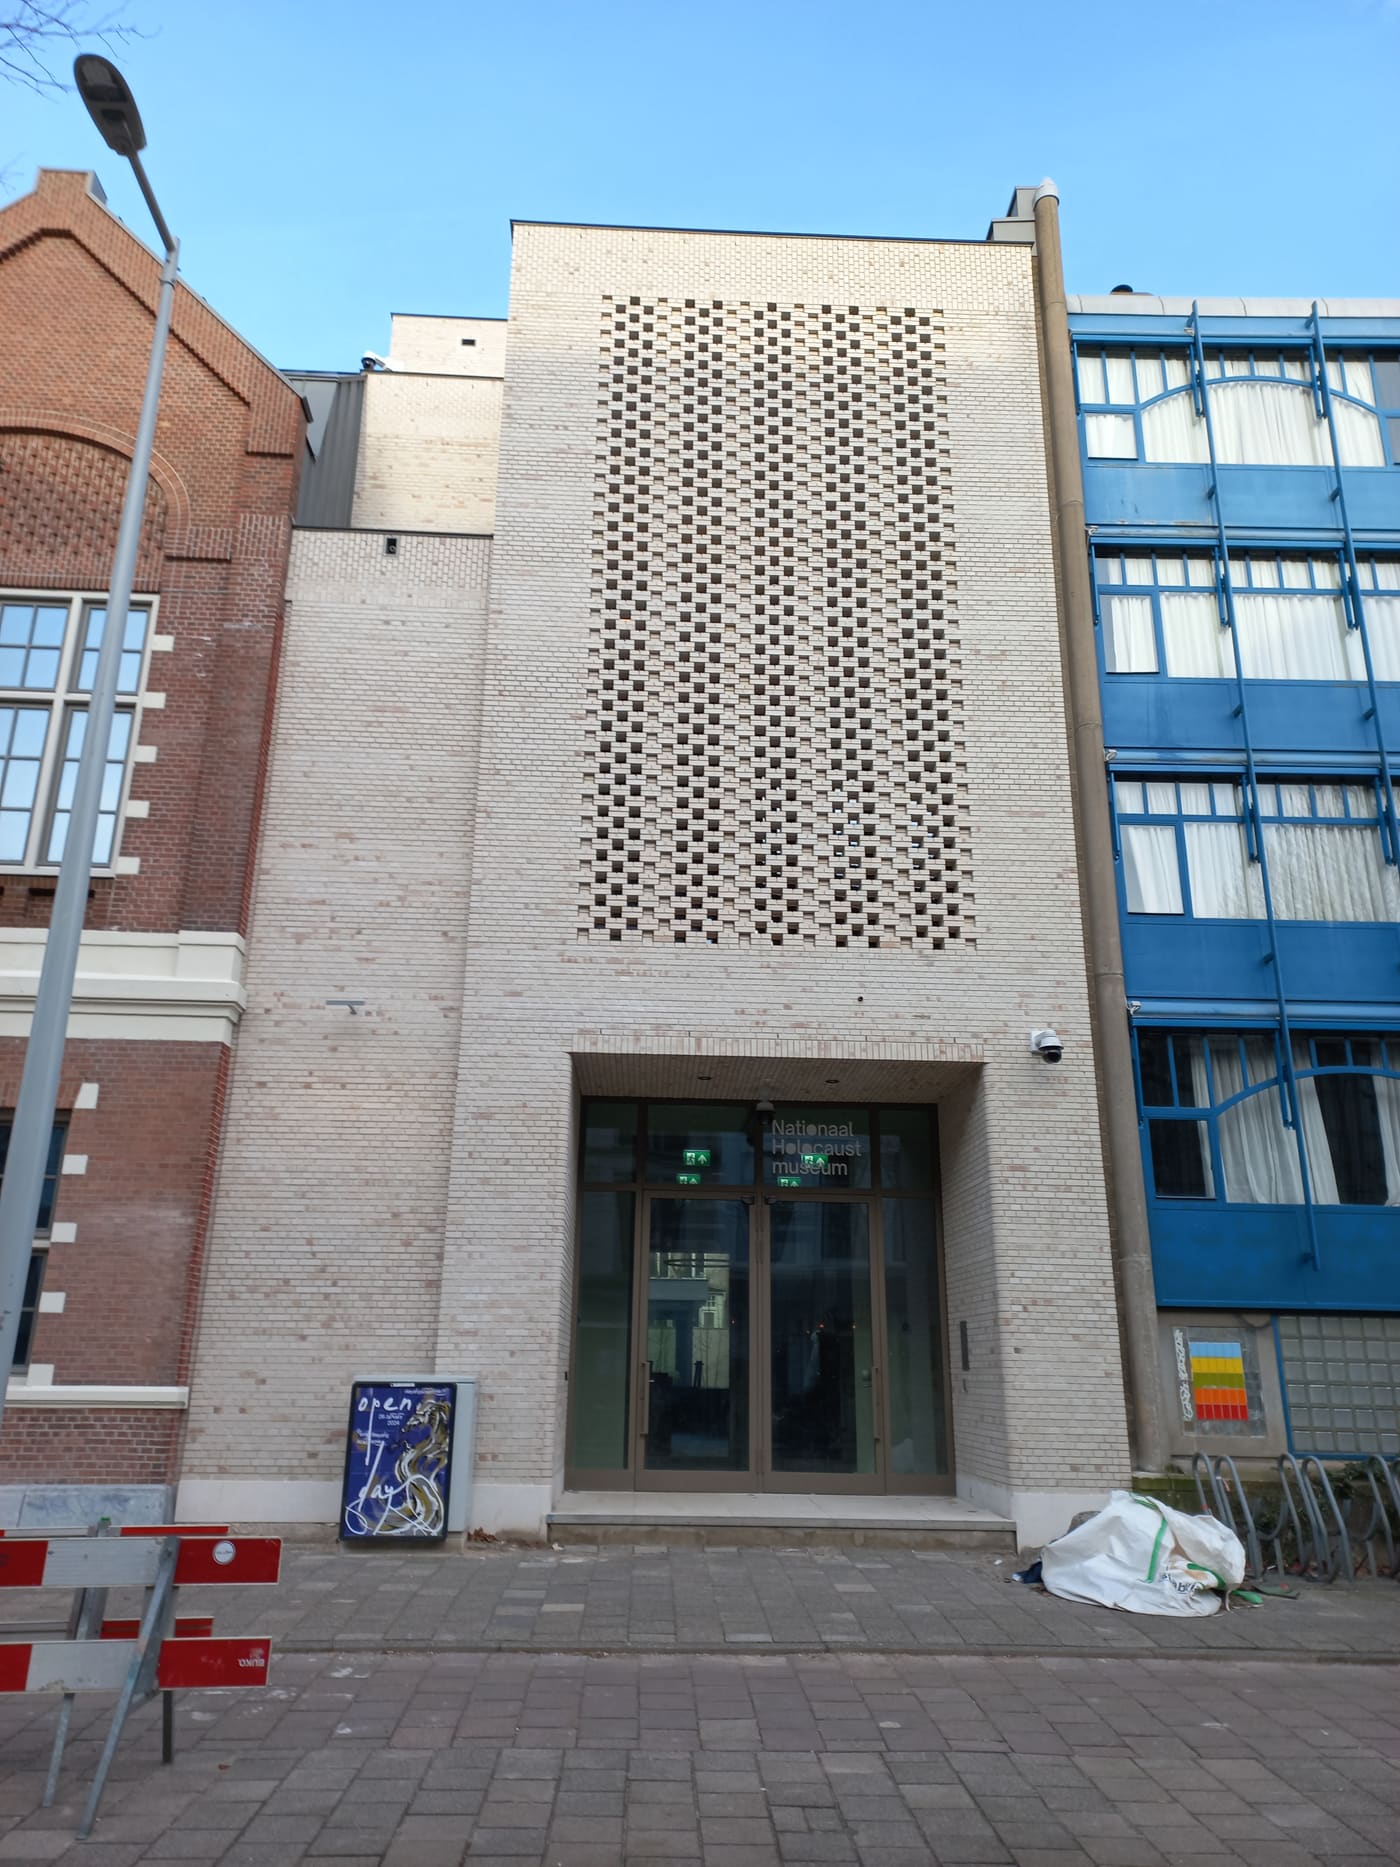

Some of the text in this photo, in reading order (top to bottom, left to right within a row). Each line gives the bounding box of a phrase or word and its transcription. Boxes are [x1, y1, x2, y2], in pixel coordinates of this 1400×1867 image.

[772, 1119, 854, 1137] Nationaal
[772, 1138, 862, 1157] Holocaust
[772, 1160, 848, 1176] museum
[358, 1396, 411, 1466] open
